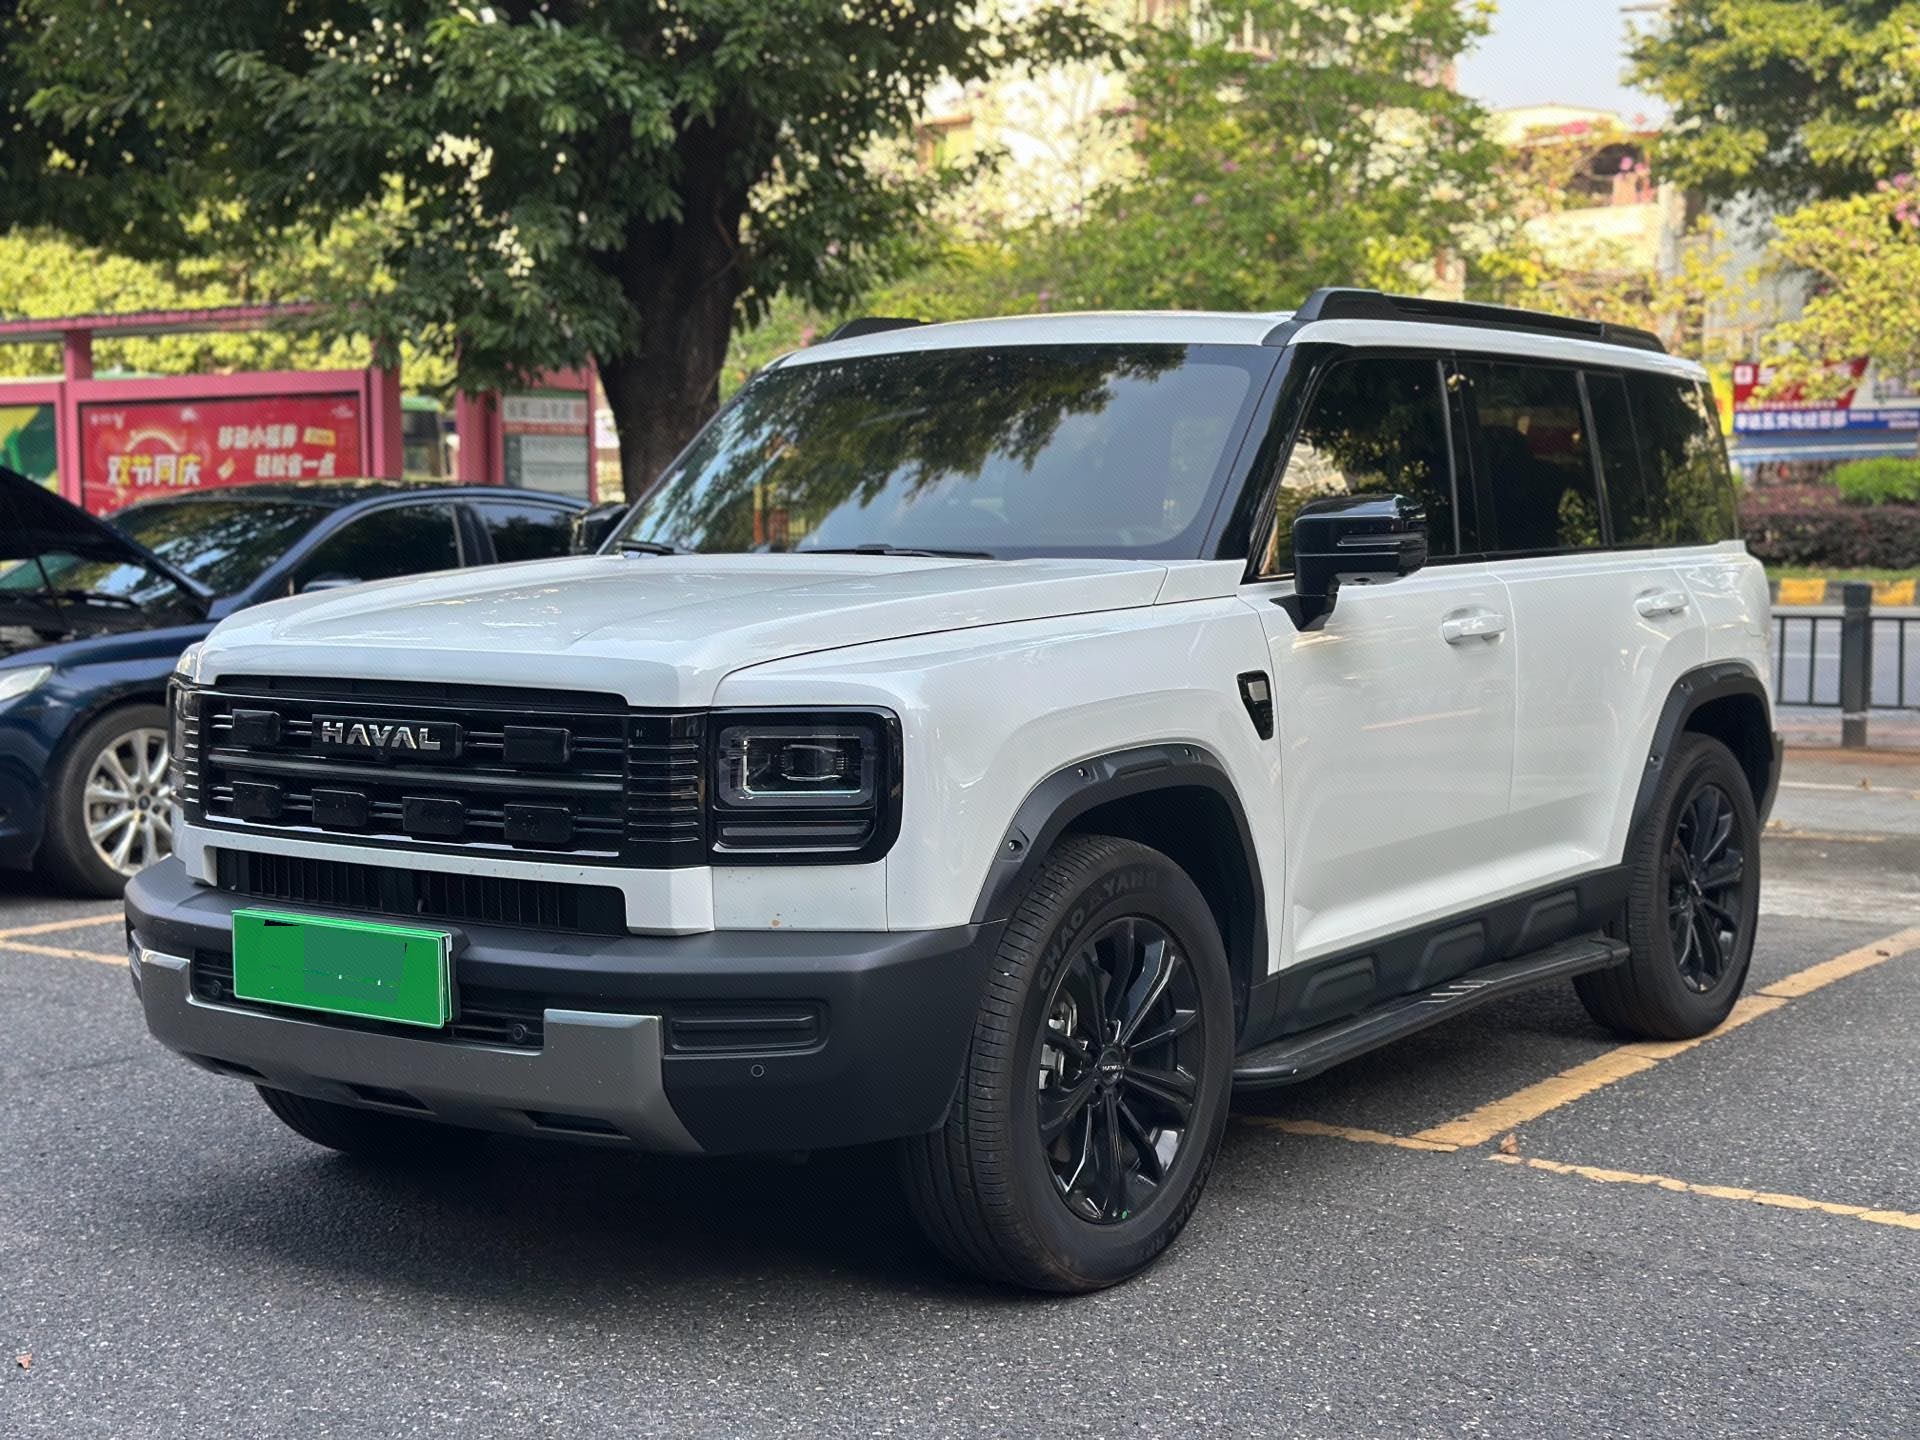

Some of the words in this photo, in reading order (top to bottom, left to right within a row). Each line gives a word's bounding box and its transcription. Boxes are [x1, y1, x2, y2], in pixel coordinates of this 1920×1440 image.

[107, 453, 201, 487] 双节同庆
[321, 721, 441, 751] HAVAL
